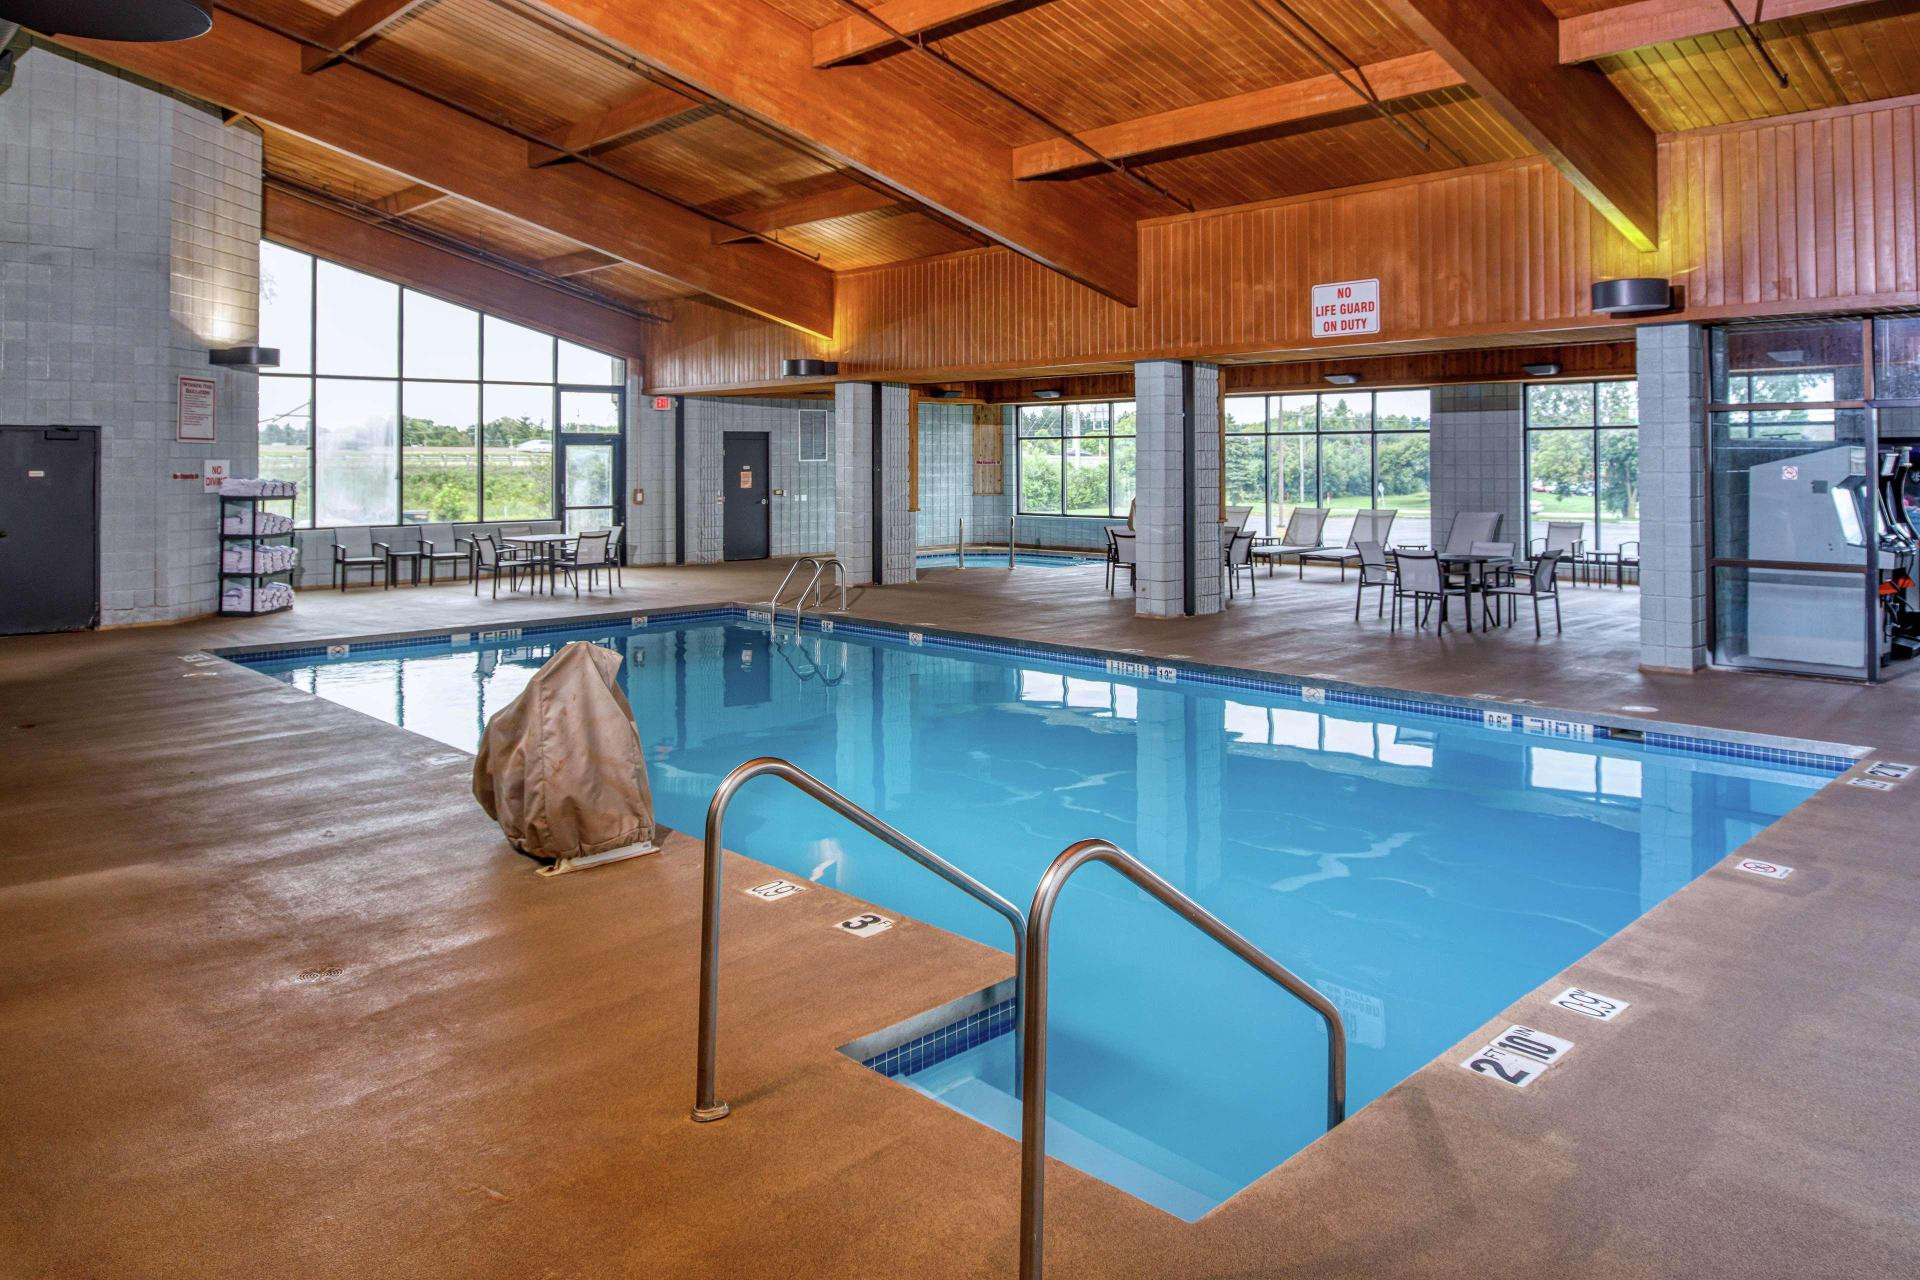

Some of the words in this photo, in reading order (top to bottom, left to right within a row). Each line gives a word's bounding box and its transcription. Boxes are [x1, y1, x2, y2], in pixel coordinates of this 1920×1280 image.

[1337, 287, 1352, 299] NO
[1315, 304, 1336, 317] LIFE
[1340, 301, 1375, 315] GUARD
[1323, 321, 1337, 332] ON
[1340, 318, 1367, 331] DUTY
[211, 465, 222, 474] NO
[841, 914, 882, 931] 3
[1498, 1035, 1557, 1060] 10
